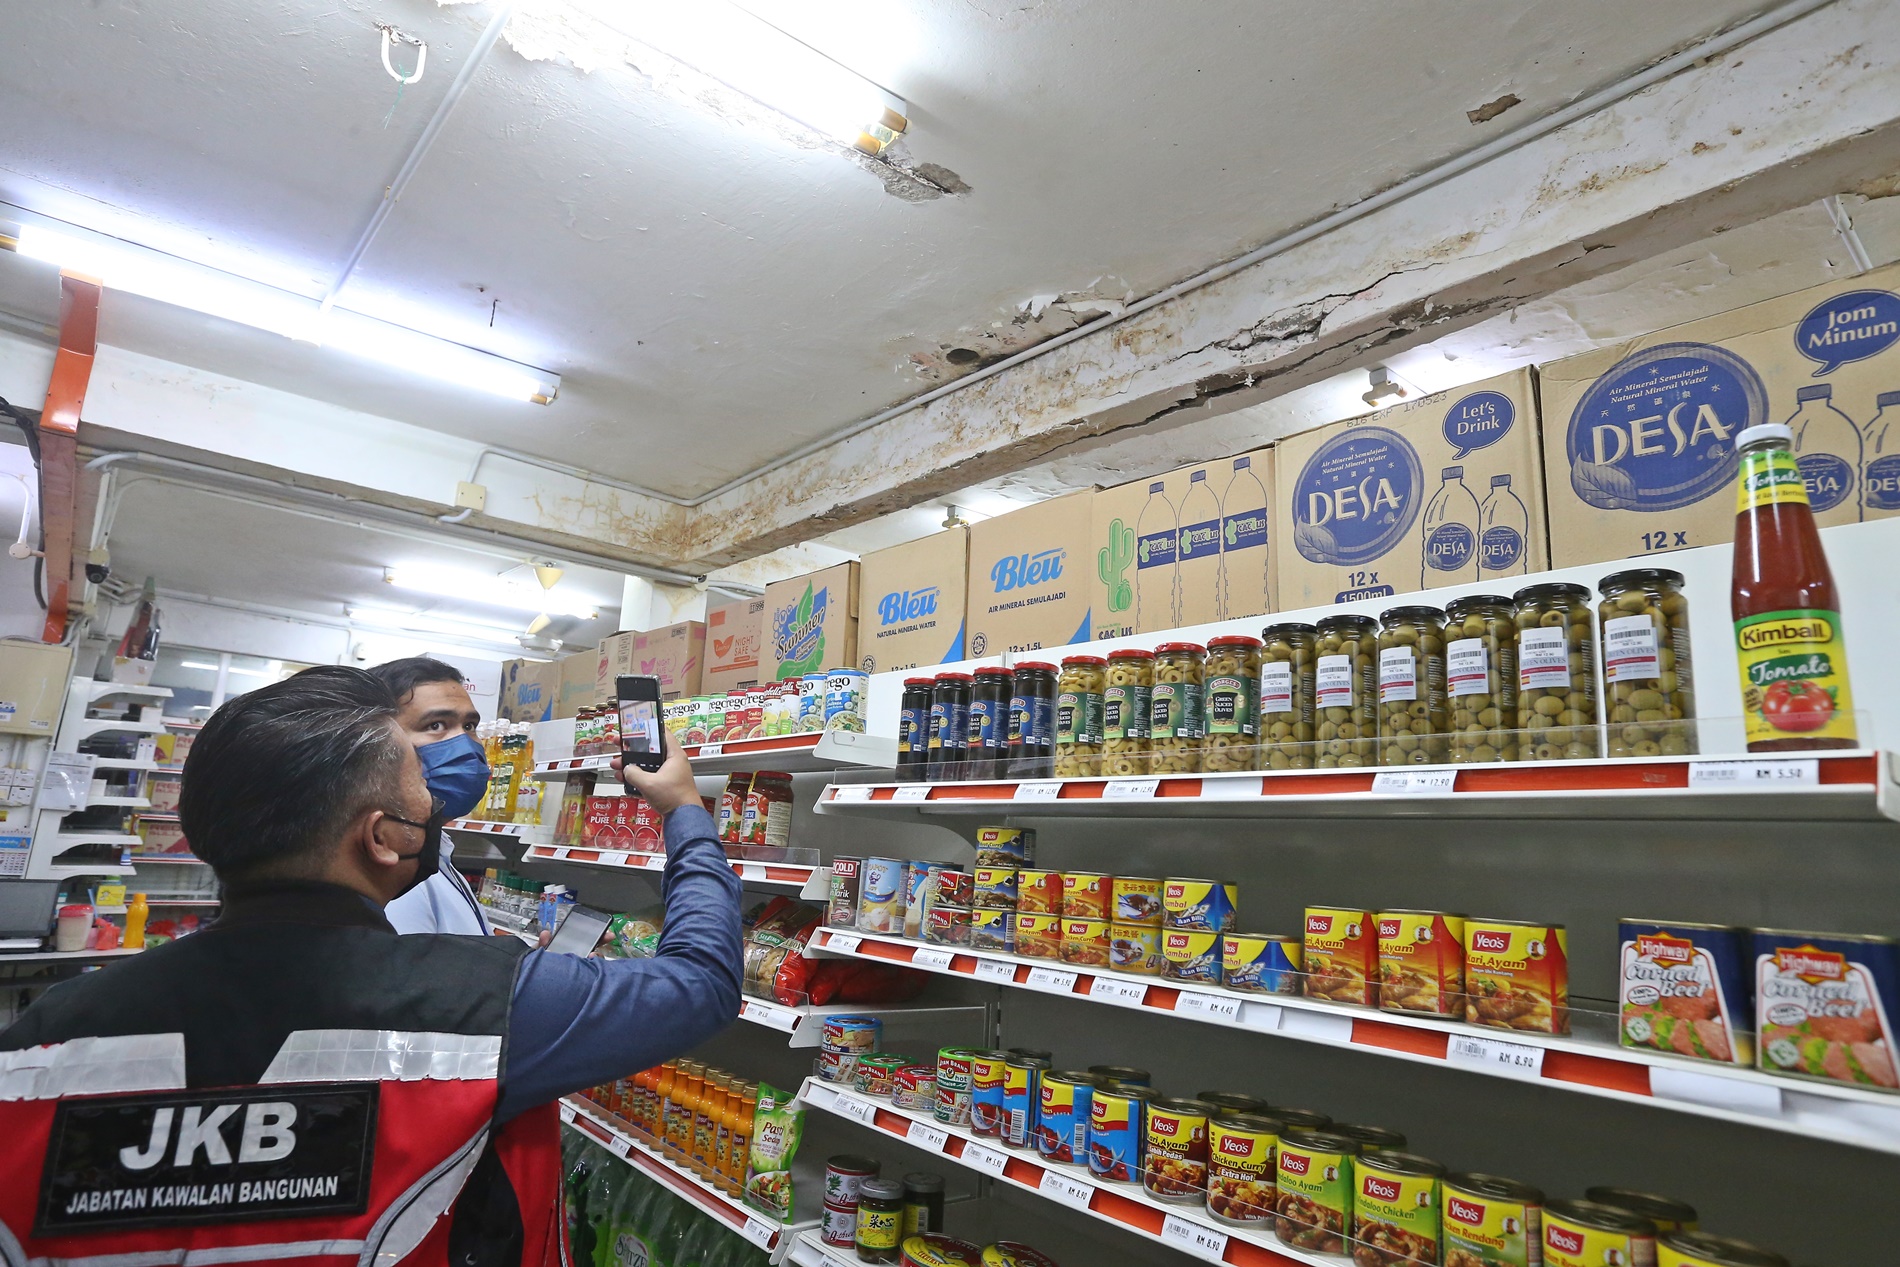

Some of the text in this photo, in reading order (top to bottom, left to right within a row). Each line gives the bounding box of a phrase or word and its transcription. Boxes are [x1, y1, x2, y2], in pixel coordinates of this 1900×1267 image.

[1828, 306, 1876, 329] Jom
[1808, 321, 1897, 349] Minum
[1609, 365, 1709, 396] Air Mineral Semulajadi
[1611, 375, 1708, 404] Natural Mineral Water
[1462, 402, 1495, 420] Let's
[1457, 416, 1500, 436] Drink
[1592, 401, 1736, 467] DESA
[1321, 446, 1388, 468] Air Mineral Semulajadi
[1322, 453, 1387, 475] Natural Mineral Water
[1308, 475, 1404, 527] DESA
[1641, 531, 1687, 550] 12 x
[1433, 541, 1467, 556] DESA
[1483, 543, 1514, 557] DESA
[991, 547, 1064, 593] Bleu
[1348, 572, 1379, 587] 12 x
[878, 586, 938, 626] Bleu
[988, 591, 1066, 614] AIR MINERAL SEMULAJADI
[776, 608, 824, 660] Summer
[876, 620, 936, 639] NATURAL MINERAL WATER
[1743, 623, 1824, 646] Kimball
[735, 636, 754, 646] NIGHT
[1027, 642, 1042, 651] 1.5L
[735, 646, 749, 656] SAFE
[1626, 647, 1655, 656] OLIVES
[1539, 657, 1566, 665] OLIVES
[1751, 655, 1830, 685] Tomato
[1212, 679, 1240, 689] BORGES
[1430, 778, 1450, 787] 12.90
[1168, 886, 1181, 896] Yeo's
[1165, 900, 1187, 908] Sambal
[1308, 918, 1328, 932] Yeo's
[1169, 936, 1186, 946] Yeo's
[1314, 939, 1344, 950] Ayam
[1384, 943, 1413, 954] Ayam
[1476, 934, 1505, 949] Yeo's
[1165, 949, 1192, 959] Sambal
[1639, 940, 1690, 959] Highway
[1486, 958, 1526, 971] Ayam
[1781, 953, 1841, 975] Highway
[1626, 963, 1704, 982] Corned
[1232, 977, 1244, 985] Ikan
[1659, 979, 1710, 998] Beef
[1763, 979, 1858, 1000] Corned
[1210, 1003, 1218, 1012] RM
[1806, 999, 1864, 1018] Beef
[950, 1060, 968, 1073] BRAND
[1499, 1052, 1534, 1067] RM 8.90
[868, 1068, 884, 1078] BRAND
[976, 1065, 987, 1074] Yeo's
[900, 1079, 915, 1090] BRAND
[1153, 1117, 1175, 1132] Yeo's
[119, 1101, 298, 1170] JKB
[1161, 1139, 1189, 1151] Ayam
[1224, 1138, 1249, 1153] Yeo's
[1162, 1150, 1183, 1160] Pedas
[1212, 1152, 1266, 1173] Chicken Curry
[1282, 1154, 1305, 1171] Yeo's
[1221, 1168, 1254, 1181] Extra Hot
[1067, 1186, 1088, 1200] RM 8.90
[1298, 1180, 1323, 1193] Ayam
[1367, 1179, 1395, 1198] Yeo's
[66, 1175, 339, 1215] JABATAN KAWALAN BANGUNAN
[1383, 1206, 1415, 1220] Chicken
[1451, 1201, 1479, 1221] Yeo's
[869, 1214, 894, 1228] 菜心
[1196, 1234, 1220, 1250] RM 8.90
[1462, 1228, 1505, 1250] Rendang
[1550, 1229, 1578, 1251] Yeo's
